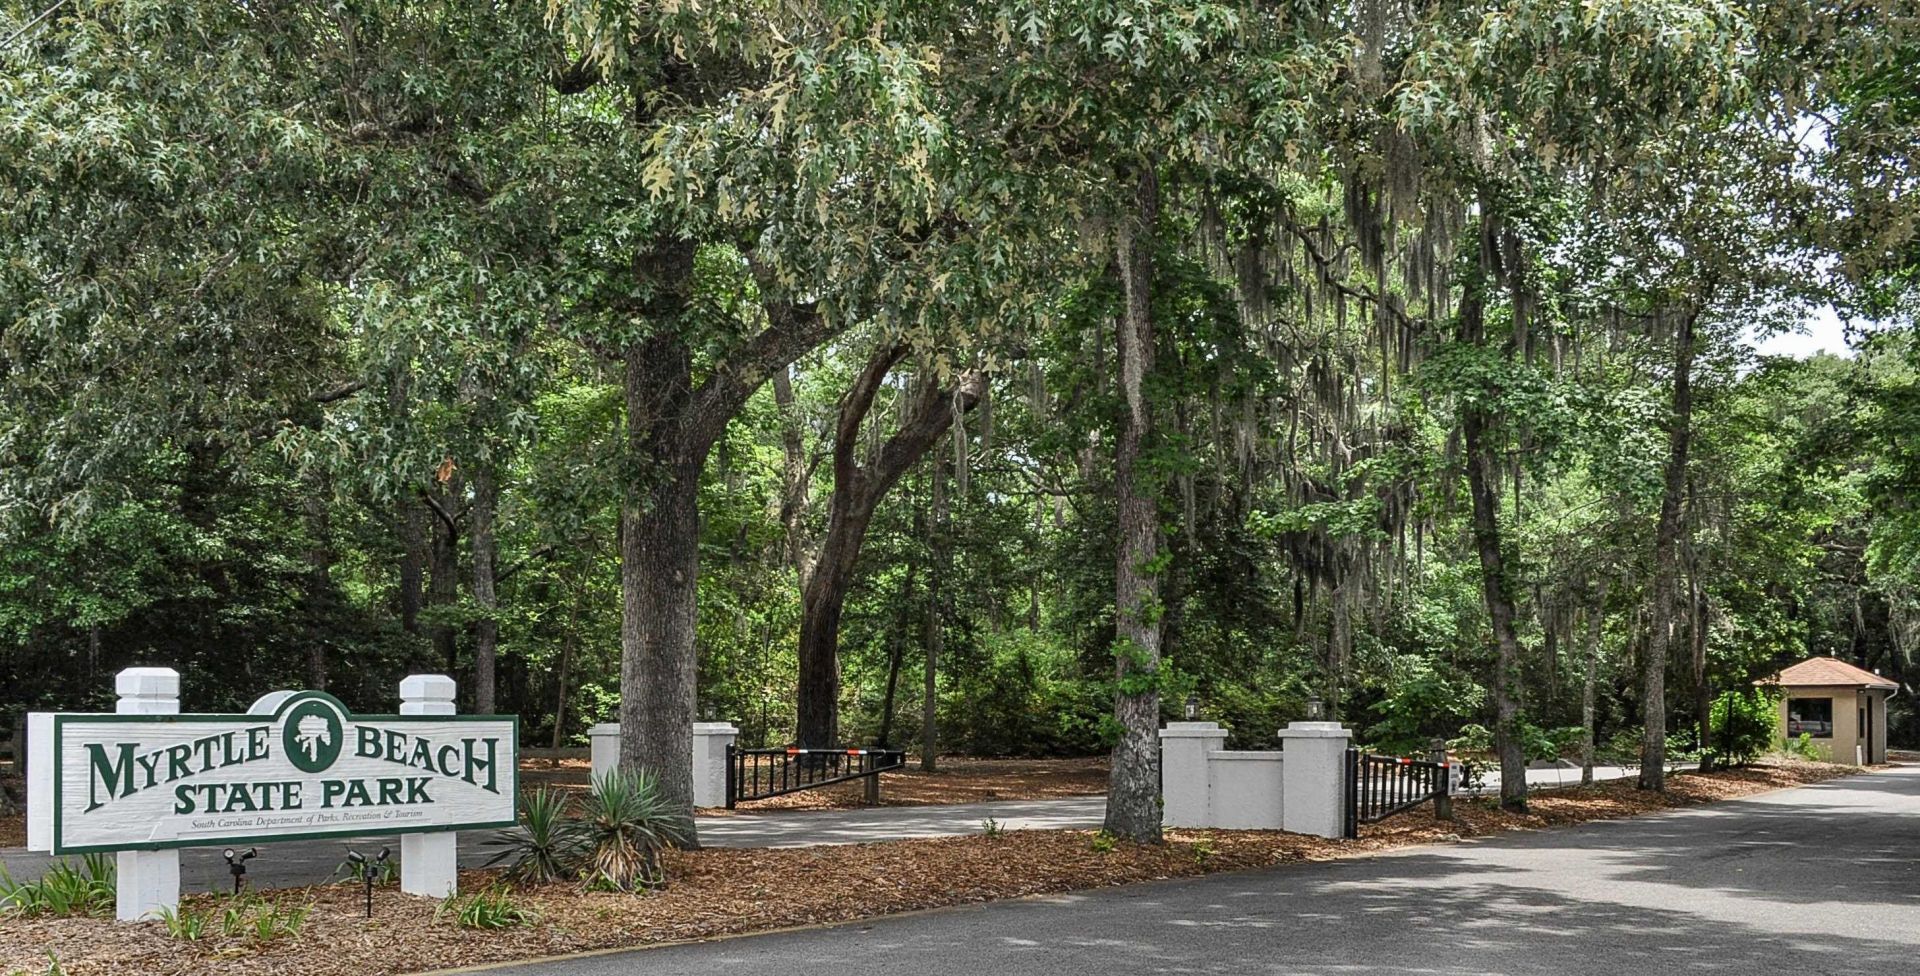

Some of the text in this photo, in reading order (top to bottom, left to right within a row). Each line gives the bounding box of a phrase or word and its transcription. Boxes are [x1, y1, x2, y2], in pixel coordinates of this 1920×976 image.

[83, 724, 501, 815] MYRTLE BEACH
[174, 776, 435, 816] STATE PARK
[191, 819, 216, 830] South
[217, 818, 253, 828] Carolina
[256, 816, 304, 828] Department
[306, 814, 316, 826] of
[342, 812, 381, 821] Recreation
[383, 810, 393, 819] &
[395, 809, 423, 818] Tourism
